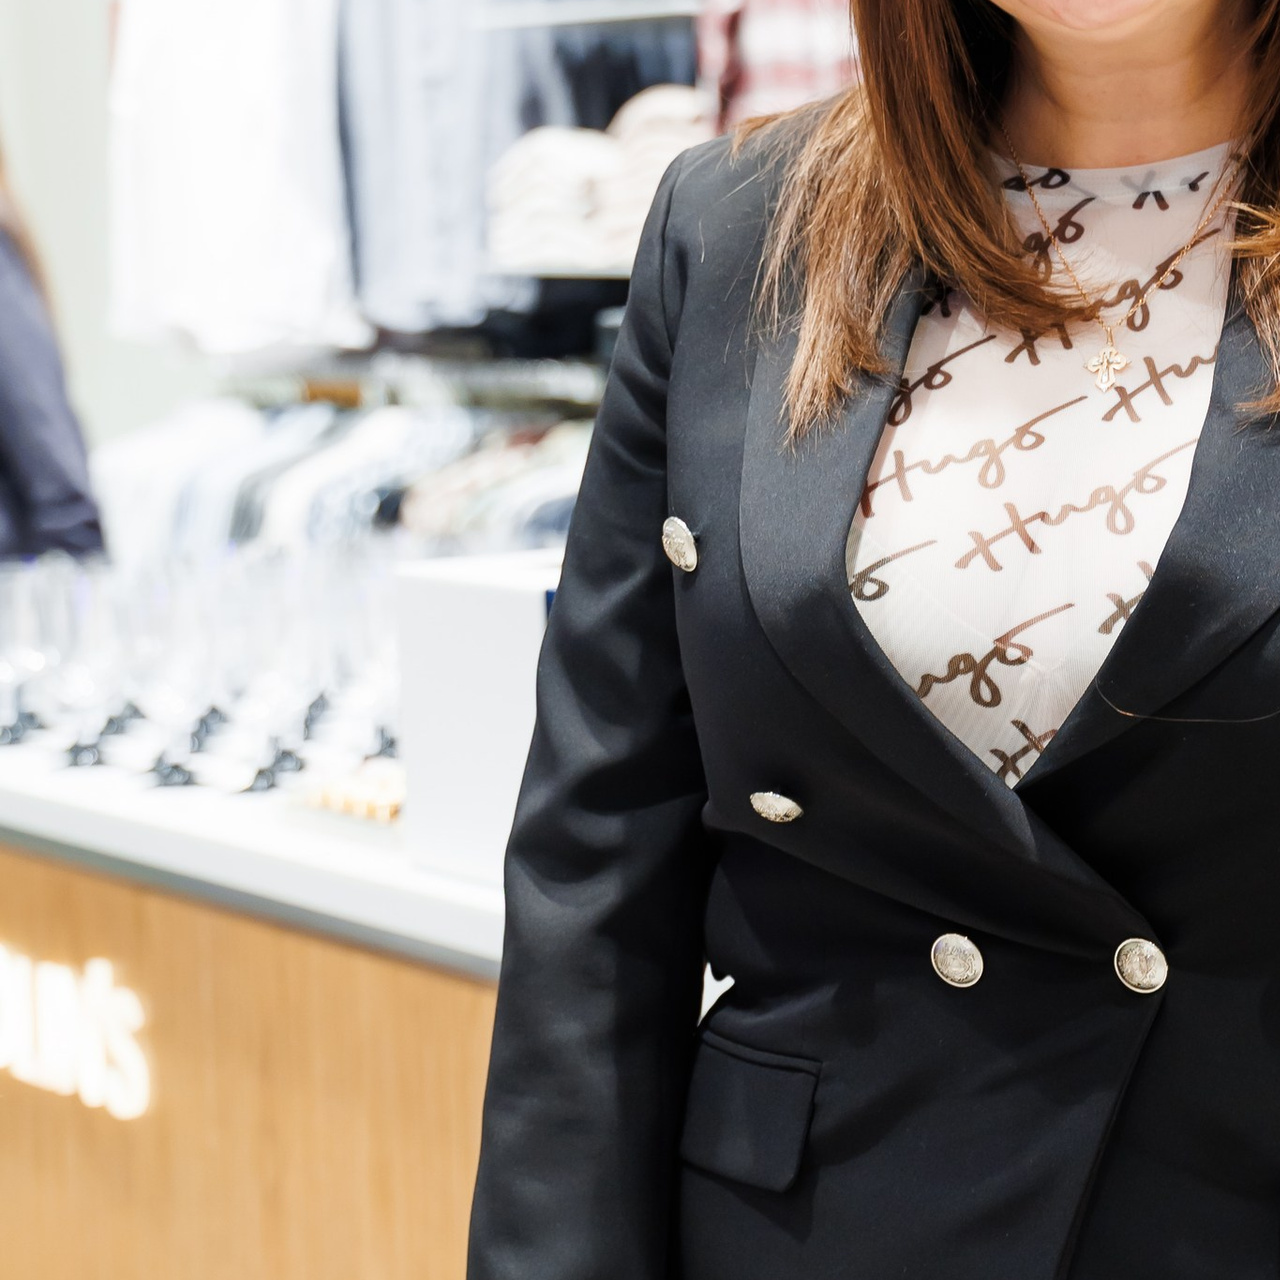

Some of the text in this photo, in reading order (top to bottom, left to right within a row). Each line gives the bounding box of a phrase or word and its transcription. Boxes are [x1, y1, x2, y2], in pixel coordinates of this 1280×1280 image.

[887, 334, 997, 426] go
[1101, 344, 1219, 423] Hu
[861, 396, 1088, 519] Hugo
[954, 438, 1200, 572] Hugo
